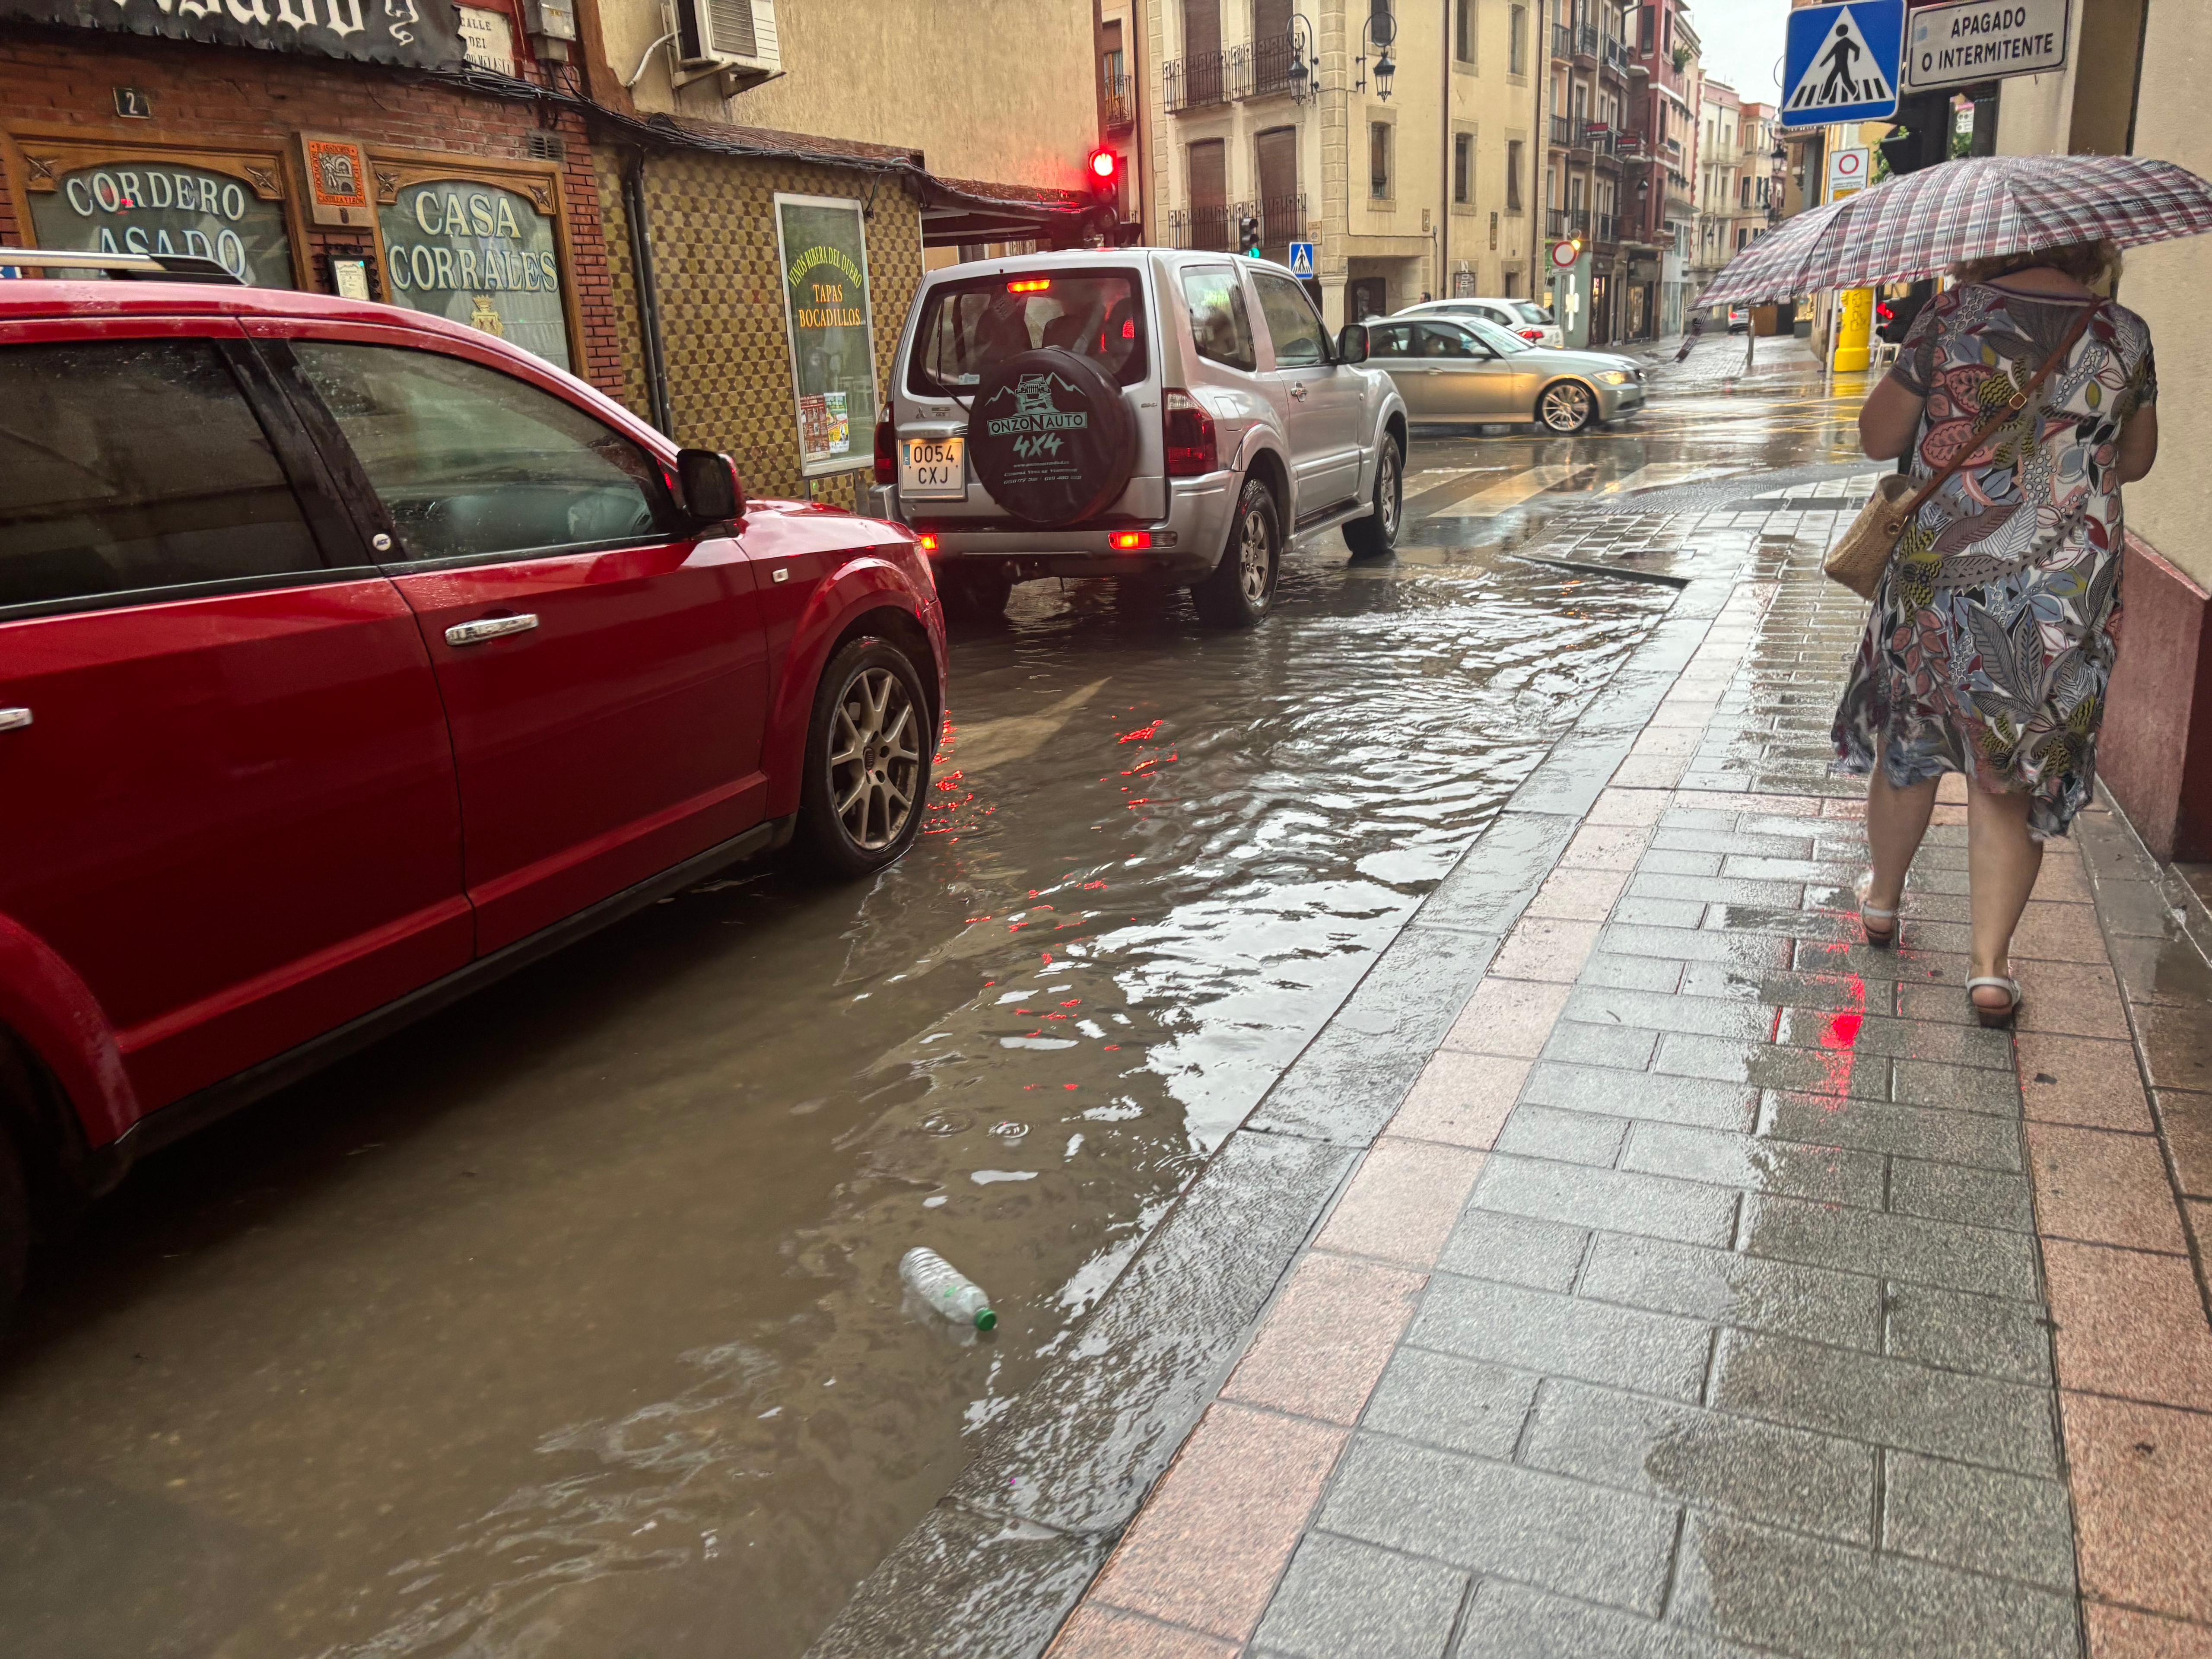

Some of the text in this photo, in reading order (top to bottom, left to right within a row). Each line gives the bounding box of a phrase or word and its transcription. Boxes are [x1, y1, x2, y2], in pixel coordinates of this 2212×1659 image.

[1951, 7, 2025, 38] APAGADO
[469, 36, 487, 48] DEL
[1922, 32, 2053, 72] O INTERMITENTE
[126, 92, 138, 114] 2
[67, 172, 245, 220] CORDERO
[416, 191, 522, 238] CASA
[389, 245, 558, 292] CORRALES
[788, 246, 862, 289] VINOS RIBERA DEL DUERO
[813, 284, 842, 302] TAPAS
[798, 308, 861, 327] BOCADILLOS
[914, 445, 954, 463] 0054
[918, 467, 948, 484] CXJ
